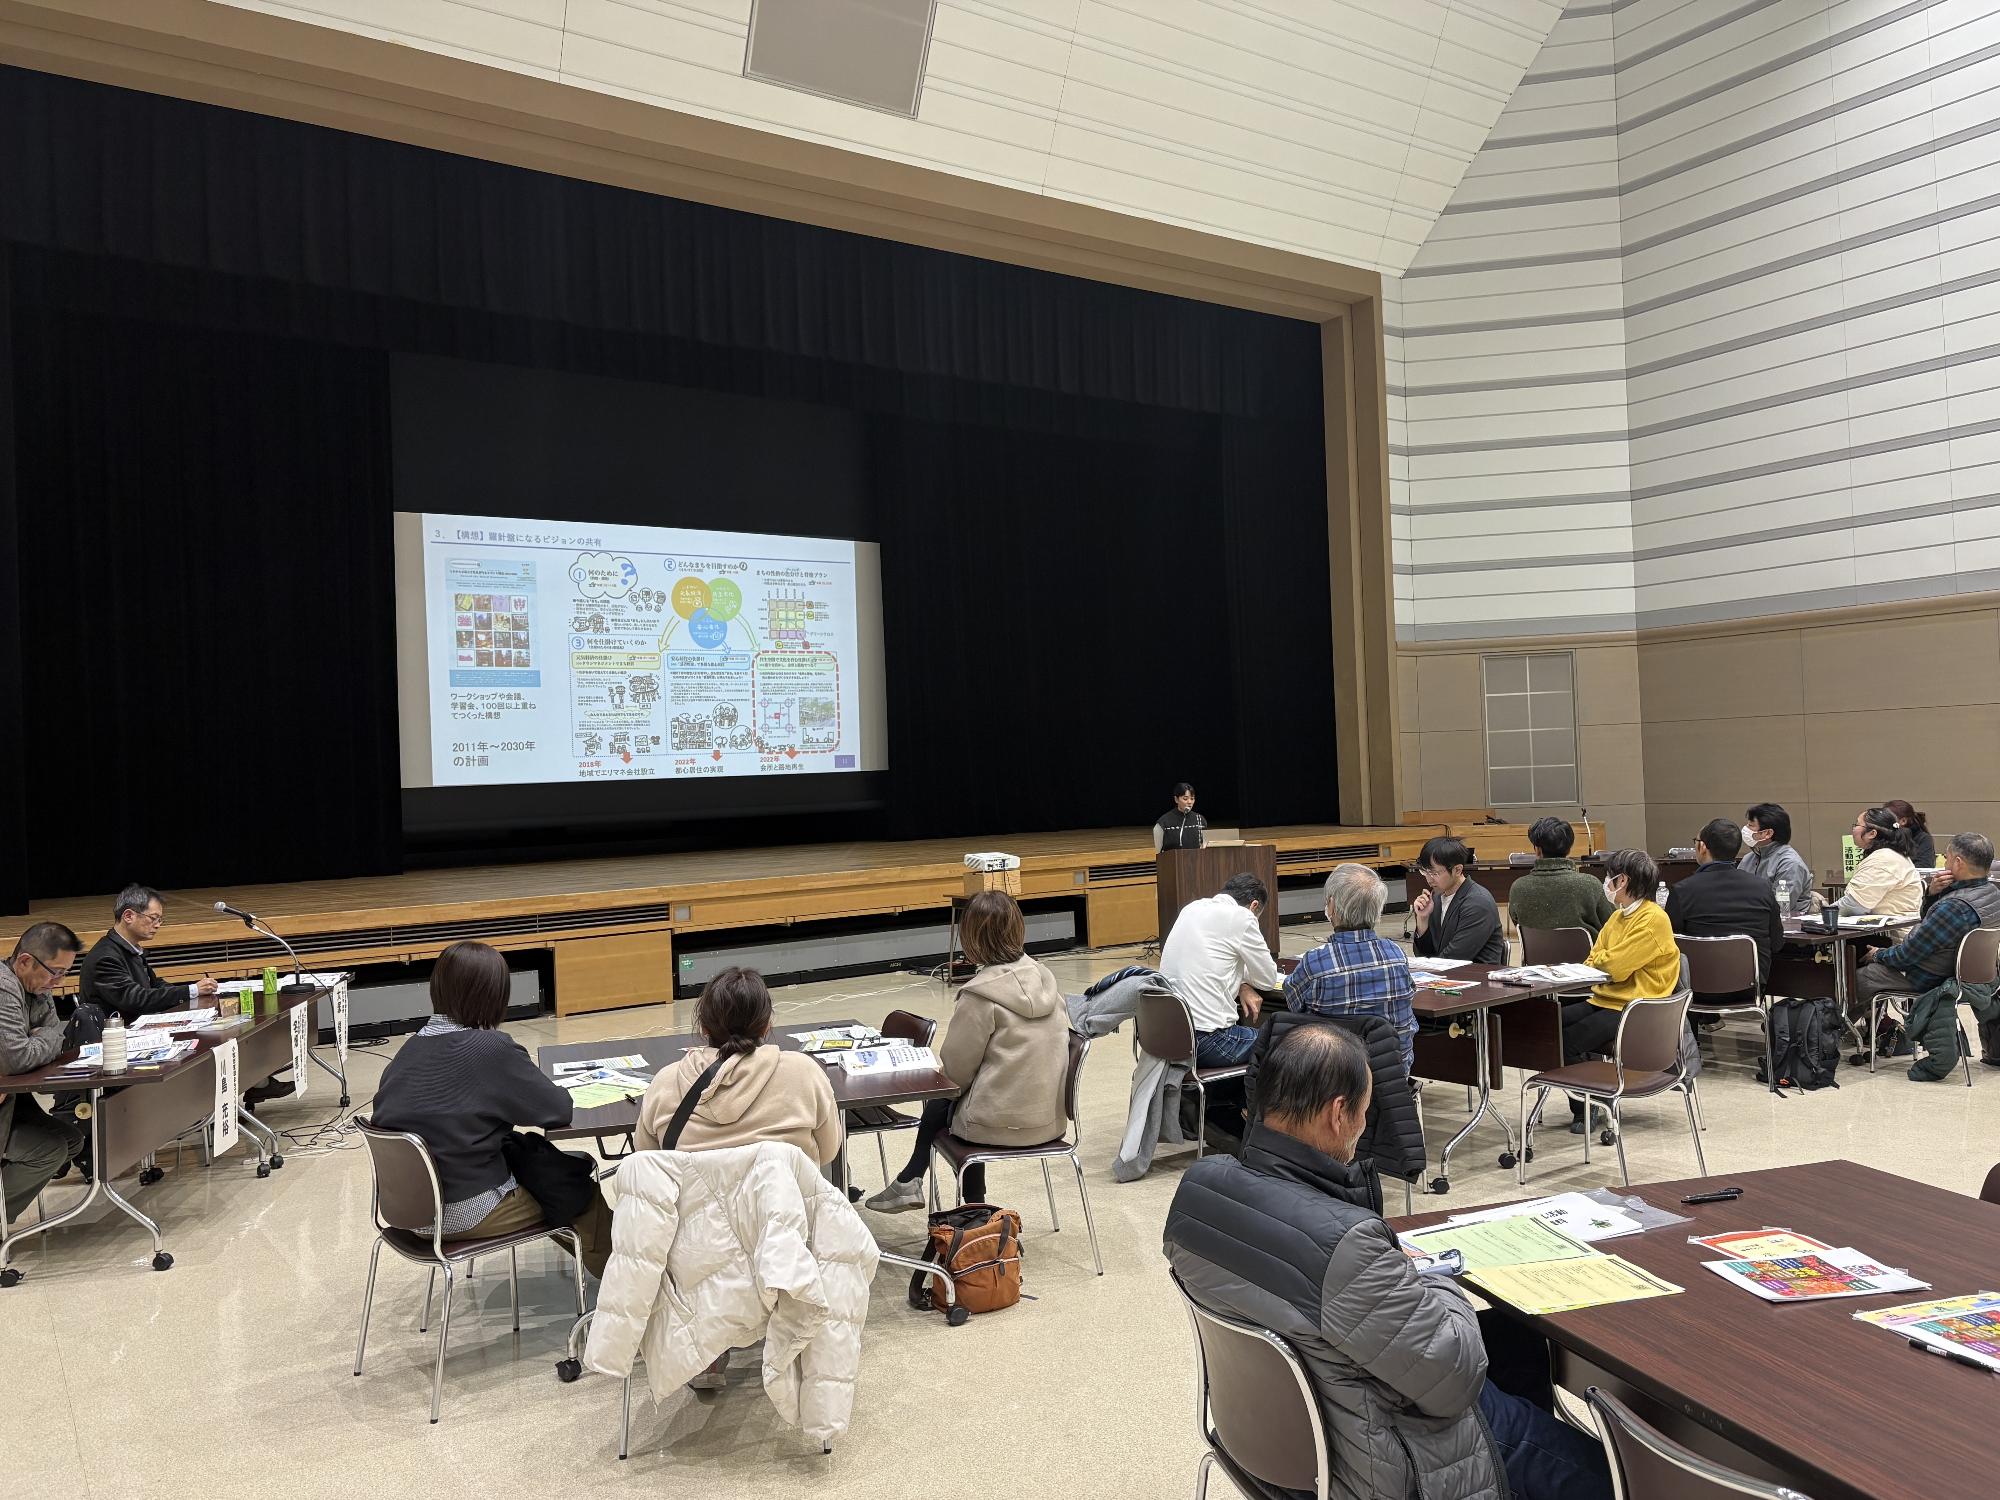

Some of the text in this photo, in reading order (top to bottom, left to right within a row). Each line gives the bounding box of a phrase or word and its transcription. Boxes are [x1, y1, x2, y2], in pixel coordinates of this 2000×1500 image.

[588, 569, 619, 577] 何のために
[450, 702, 537, 710] 学習会、100回以上重ね
[451, 711, 501, 720] てつくった構想
[453, 755, 489, 767] の計画
[675, 757, 696, 765] 2022年
[760, 755, 780, 763] 2022年
[578, 760, 601, 768] 2018年
[578, 767, 655, 777] 地域でエリマネ会社設立
[1844, 846, 1855, 872] 活動団体
